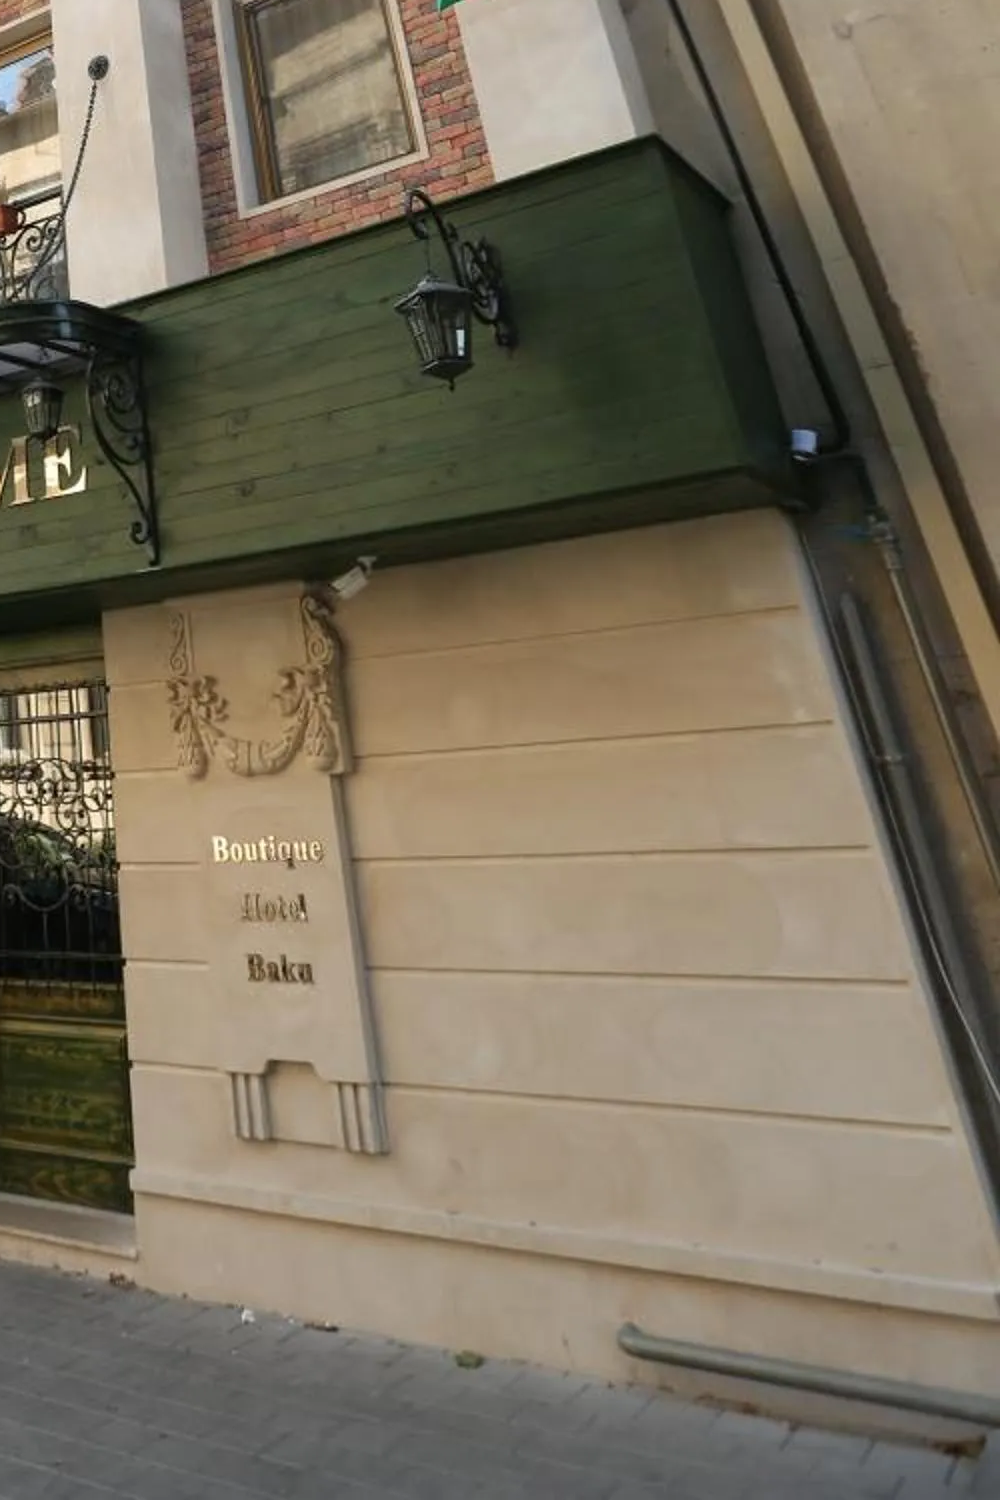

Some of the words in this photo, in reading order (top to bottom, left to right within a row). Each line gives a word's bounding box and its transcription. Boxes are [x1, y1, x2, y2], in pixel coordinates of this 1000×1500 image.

[212, 835, 325, 869] Boutique
[240, 893, 308, 923] Hotel
[247, 953, 314, 984] Baku
